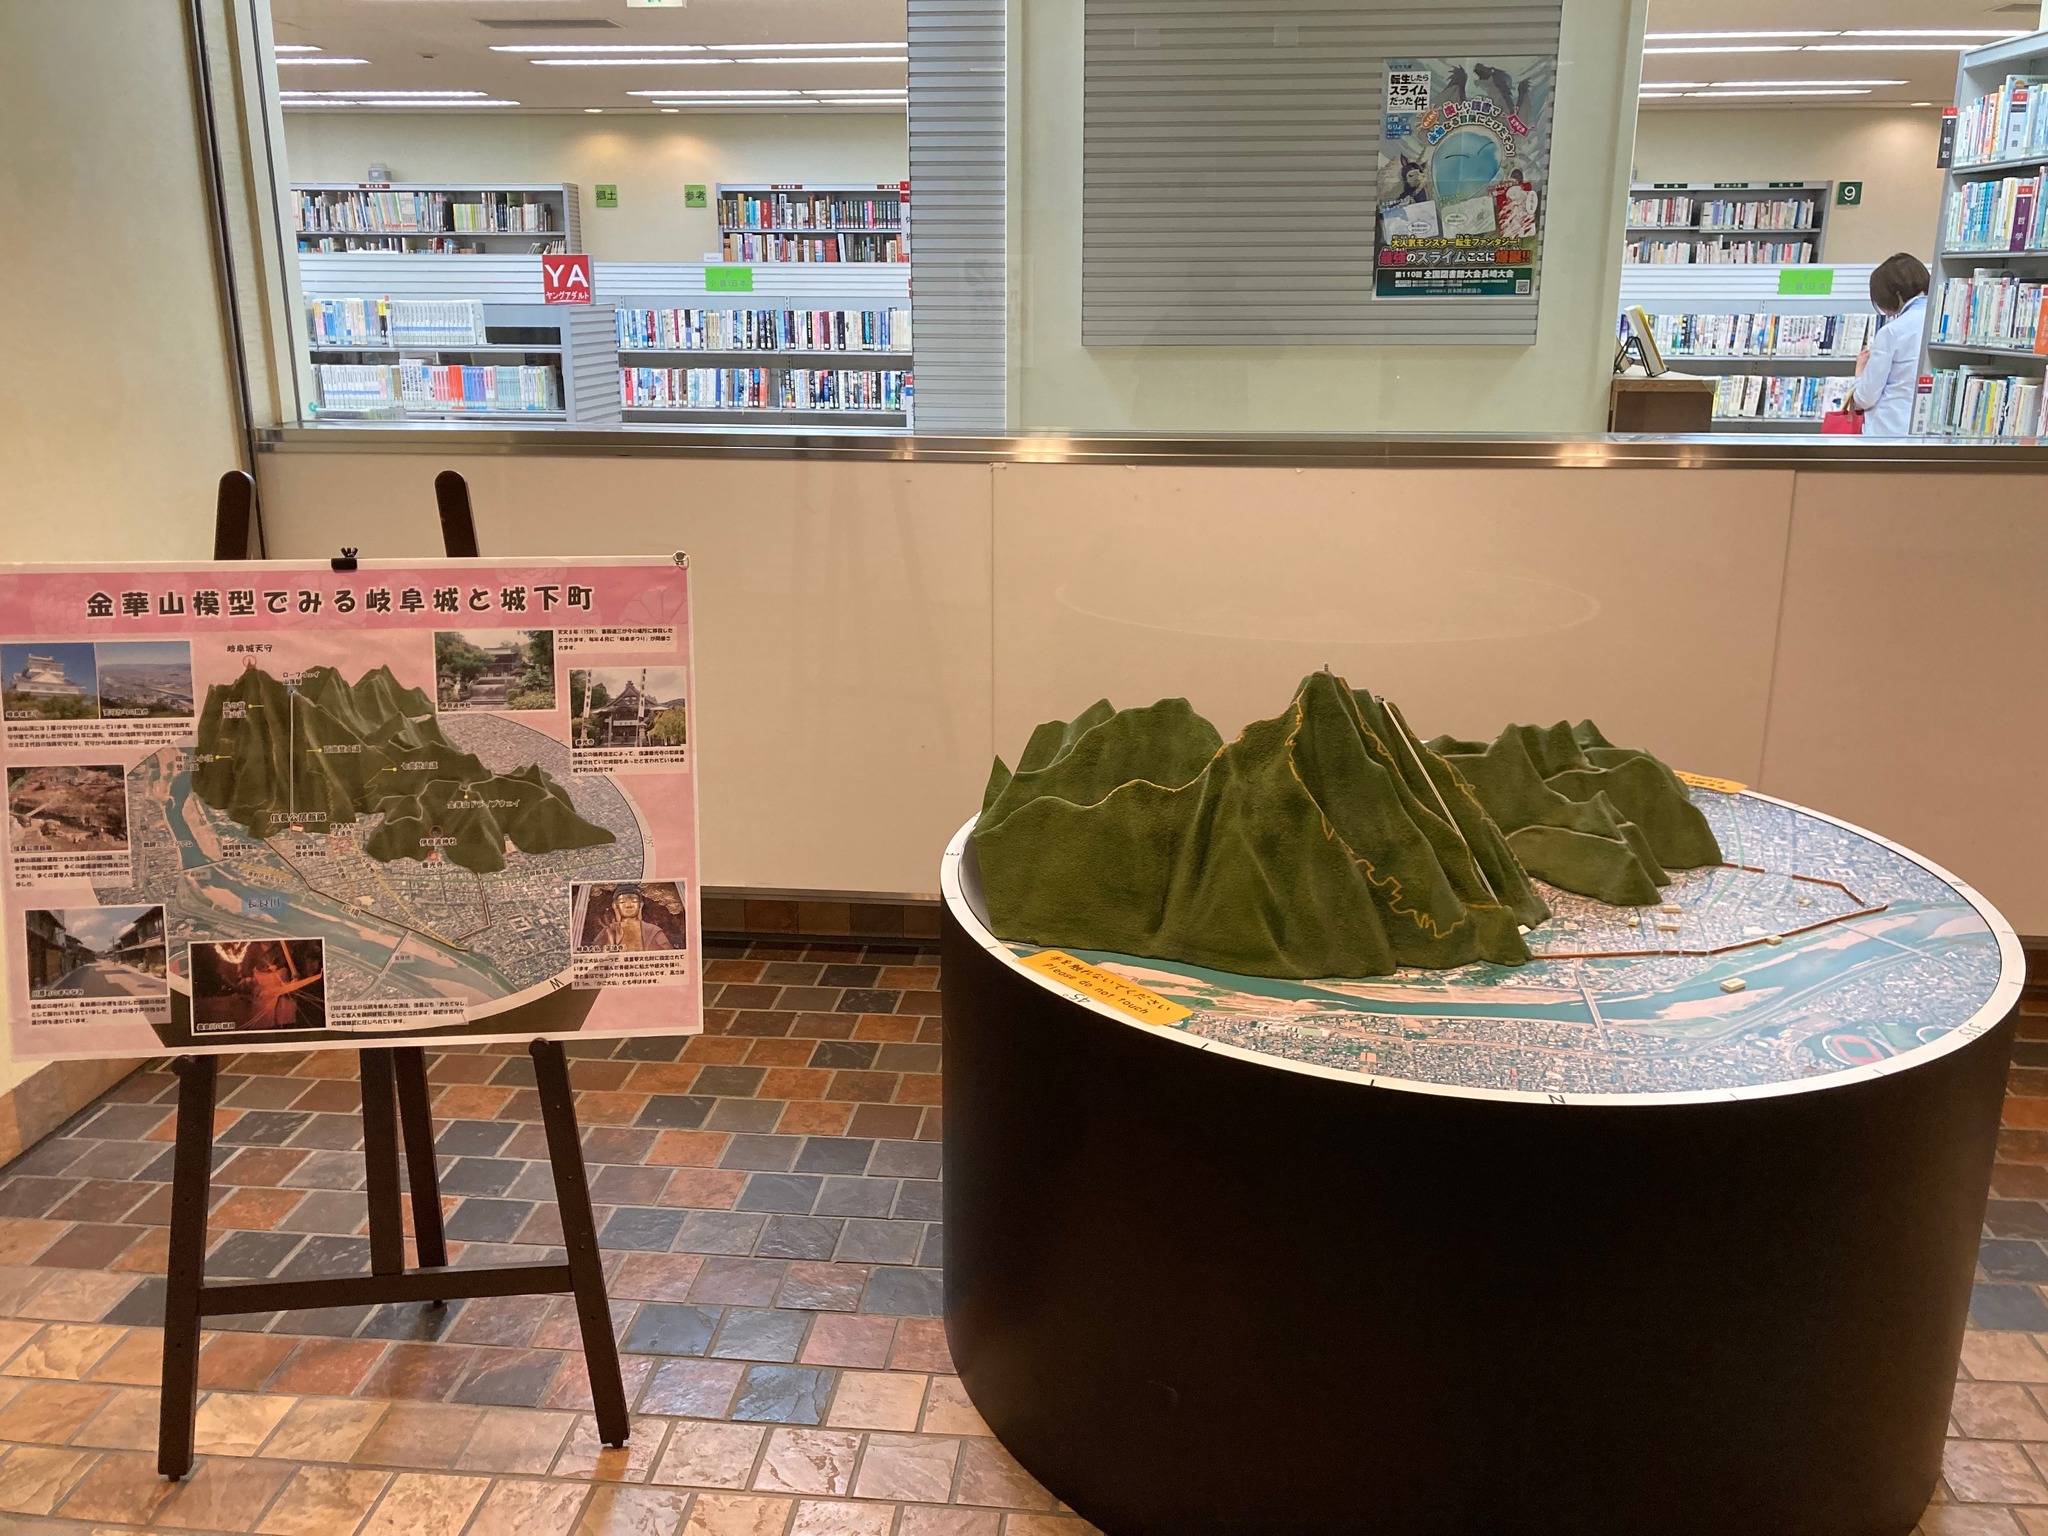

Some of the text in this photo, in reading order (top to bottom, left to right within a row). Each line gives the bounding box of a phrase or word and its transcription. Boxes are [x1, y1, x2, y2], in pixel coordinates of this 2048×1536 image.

[1390, 74, 1429, 85] 転生したら
[1390, 85, 1428, 96] スライム
[1389, 97, 1428, 111] だった件
[1443, 100, 1501, 117] 楽しい読書で
[596, 190, 617, 201] 郷土
[685, 190, 706, 201] 参考
[1843, 185, 1856, 202] 9
[1392, 238, 1520, 248] 大人気モンスター転生ファンタジー!
[544, 264, 589, 287] YA
[725, 271, 731, 279] F
[1395, 269, 1514, 279] 第110回 全国図書館大会長崎大会
[546, 291, 589, 300] ヤングアダルト
[85, 585, 594, 618] 金華山模型でみる岐阜城と城下町
[226, 643, 273, 653] 岐阜城天守
[282, 671, 320, 680] ロープウェイ
[222, 710, 247, 720] 登山道
[446, 799, 521, 810] 金華山ドライブウェイ
[270, 812, 327, 823] 信長公居館跡
[419, 837, 458, 847] 伊奈波神社
[549, 977, 565, 991] W
[1049, 955, 1171, 1012] 手を触れないでください
[1078, 979, 1093, 988] do
[1094, 987, 1116, 999] not
[1117, 997, 1150, 1015] touch
[1547, 1094, 1566, 1104] N
